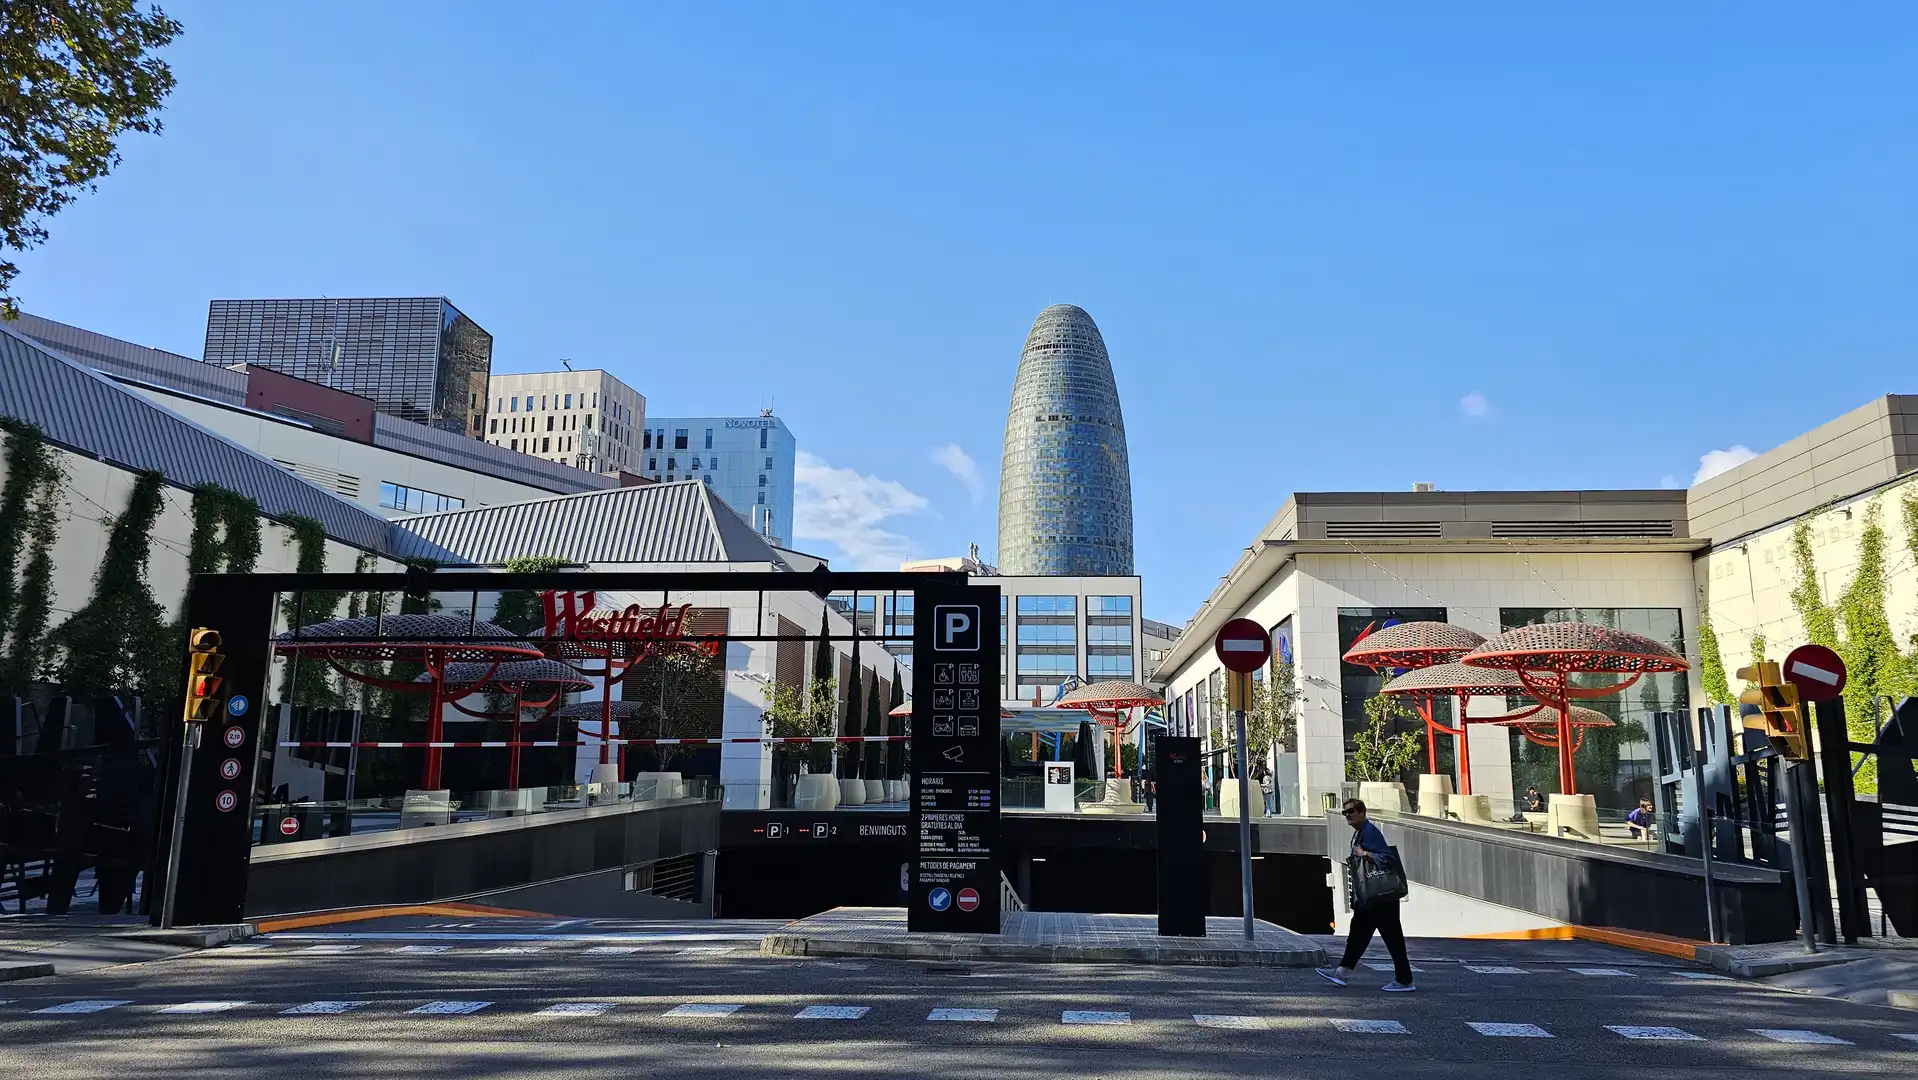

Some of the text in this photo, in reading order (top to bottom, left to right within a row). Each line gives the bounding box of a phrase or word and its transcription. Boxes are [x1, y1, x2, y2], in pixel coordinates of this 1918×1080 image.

[725, 418, 775, 429] NOVOTEL
[538, 589, 693, 640] Westfield
[945, 612, 970, 643] P
[921, 777, 944, 785] HORARIS
[222, 796, 232, 805] 10
[921, 813, 965, 821] 2 PRIMERES HORES
[770, 826, 779, 836] P
[816, 826, 825, 836] P
[859, 825, 907, 836] BENVINGUTS
[948, 822, 954, 830] AL
[954, 822, 963, 830] DIA
[949, 862, 976, 870] PAGAMENT
